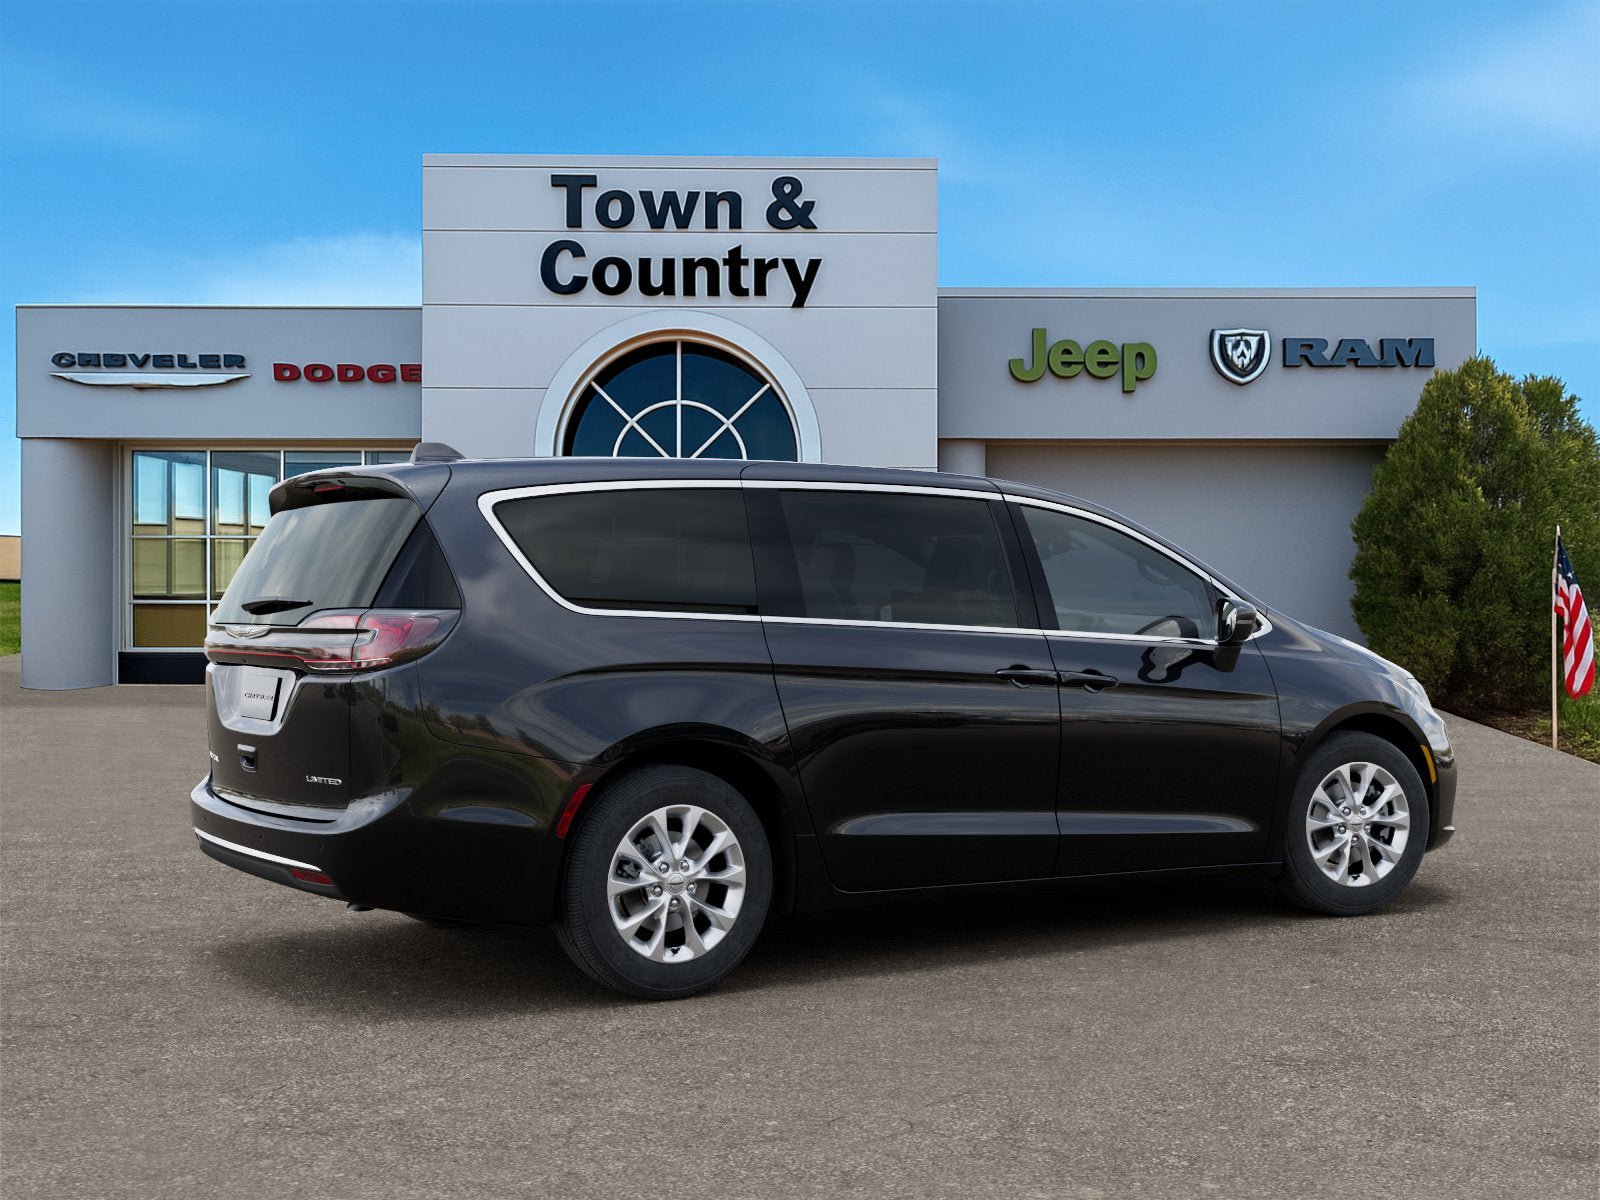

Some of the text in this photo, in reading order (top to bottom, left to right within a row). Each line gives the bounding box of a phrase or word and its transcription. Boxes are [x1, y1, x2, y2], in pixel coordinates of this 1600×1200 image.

[551, 174, 819, 230] Town &
[540, 239, 823, 308] Country
[273, 362, 422, 383] DODGE
[1009, 328, 1157, 392] Jeep
[1283, 337, 1435, 368] RAM
[305, 775, 342, 786] LIMITED
